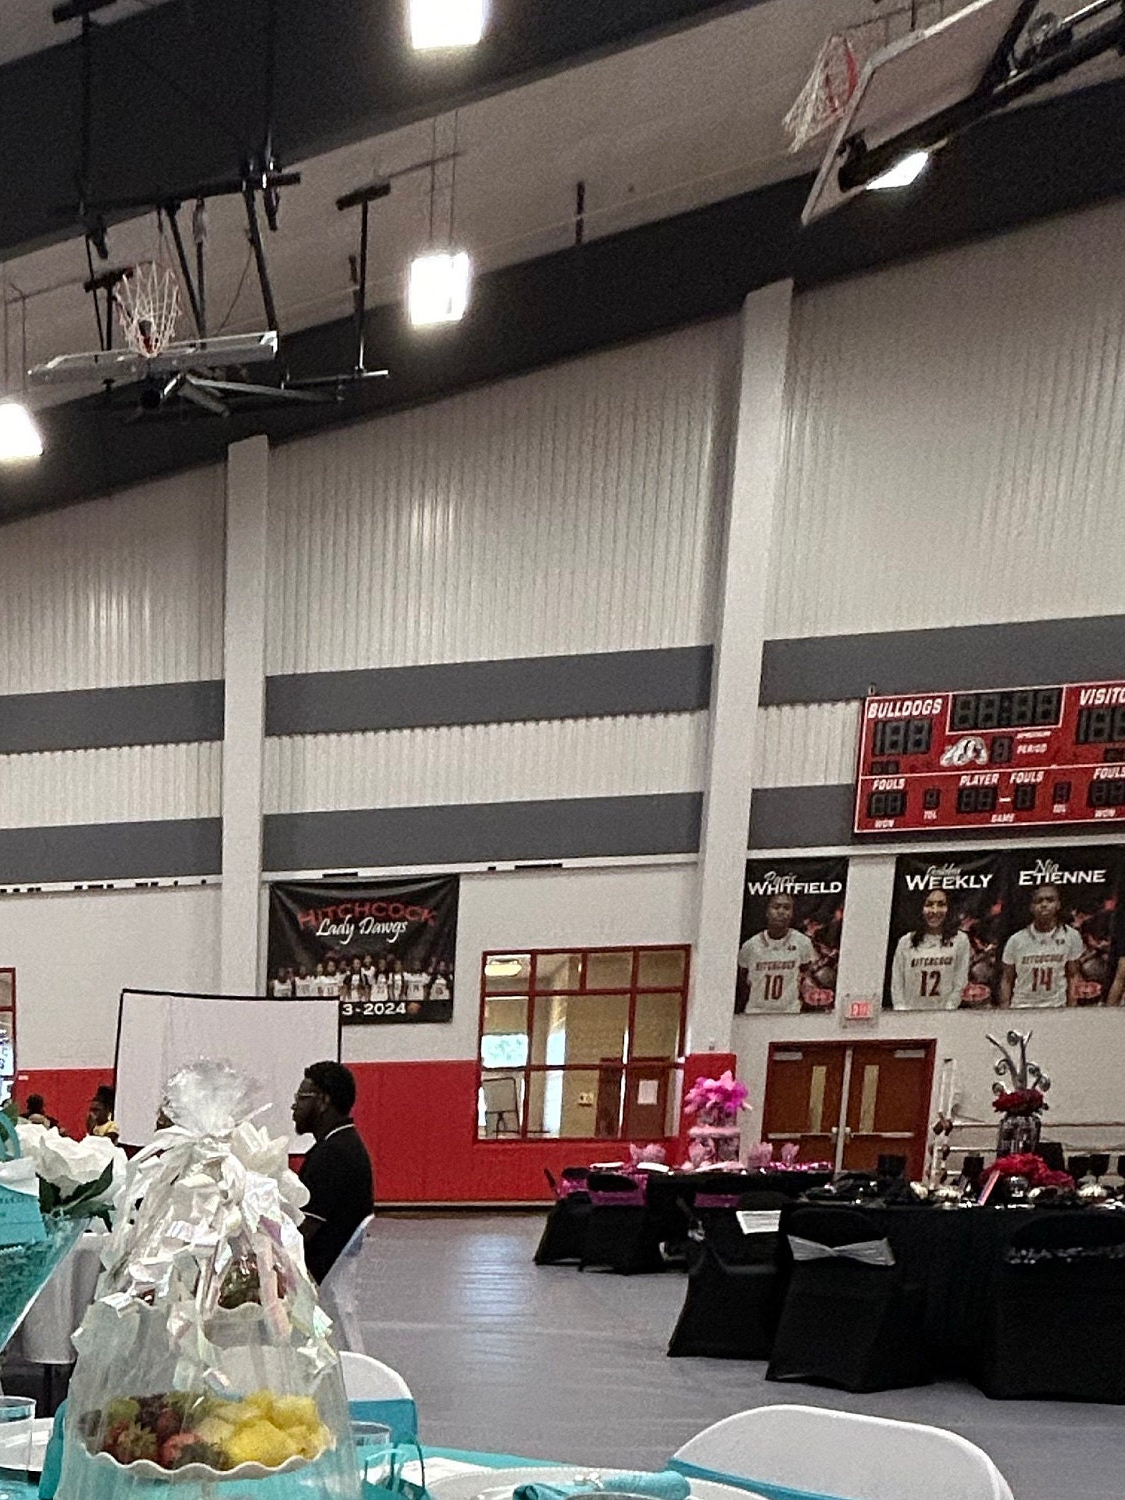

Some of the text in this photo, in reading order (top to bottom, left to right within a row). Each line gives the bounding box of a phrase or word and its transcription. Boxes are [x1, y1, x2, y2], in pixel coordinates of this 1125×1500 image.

[867, 698, 942, 719] BULLDOGS
[872, 778, 906, 791] FOULS
[959, 771, 1045, 786] PLAYER FOULS
[991, 813, 1015, 823] GAME
[905, 874, 994, 891] WEEKLY
[1019, 869, 1107, 886] ETIENNE
[748, 881, 843, 896] WHITFIELD
[297, 902, 437, 929] HITCHCOCK
[316, 914, 409, 945] Lady Dawgs
[764, 974, 784, 1001] 10
[920, 970, 942, 997] 12
[1031, 967, 1053, 992] 14
